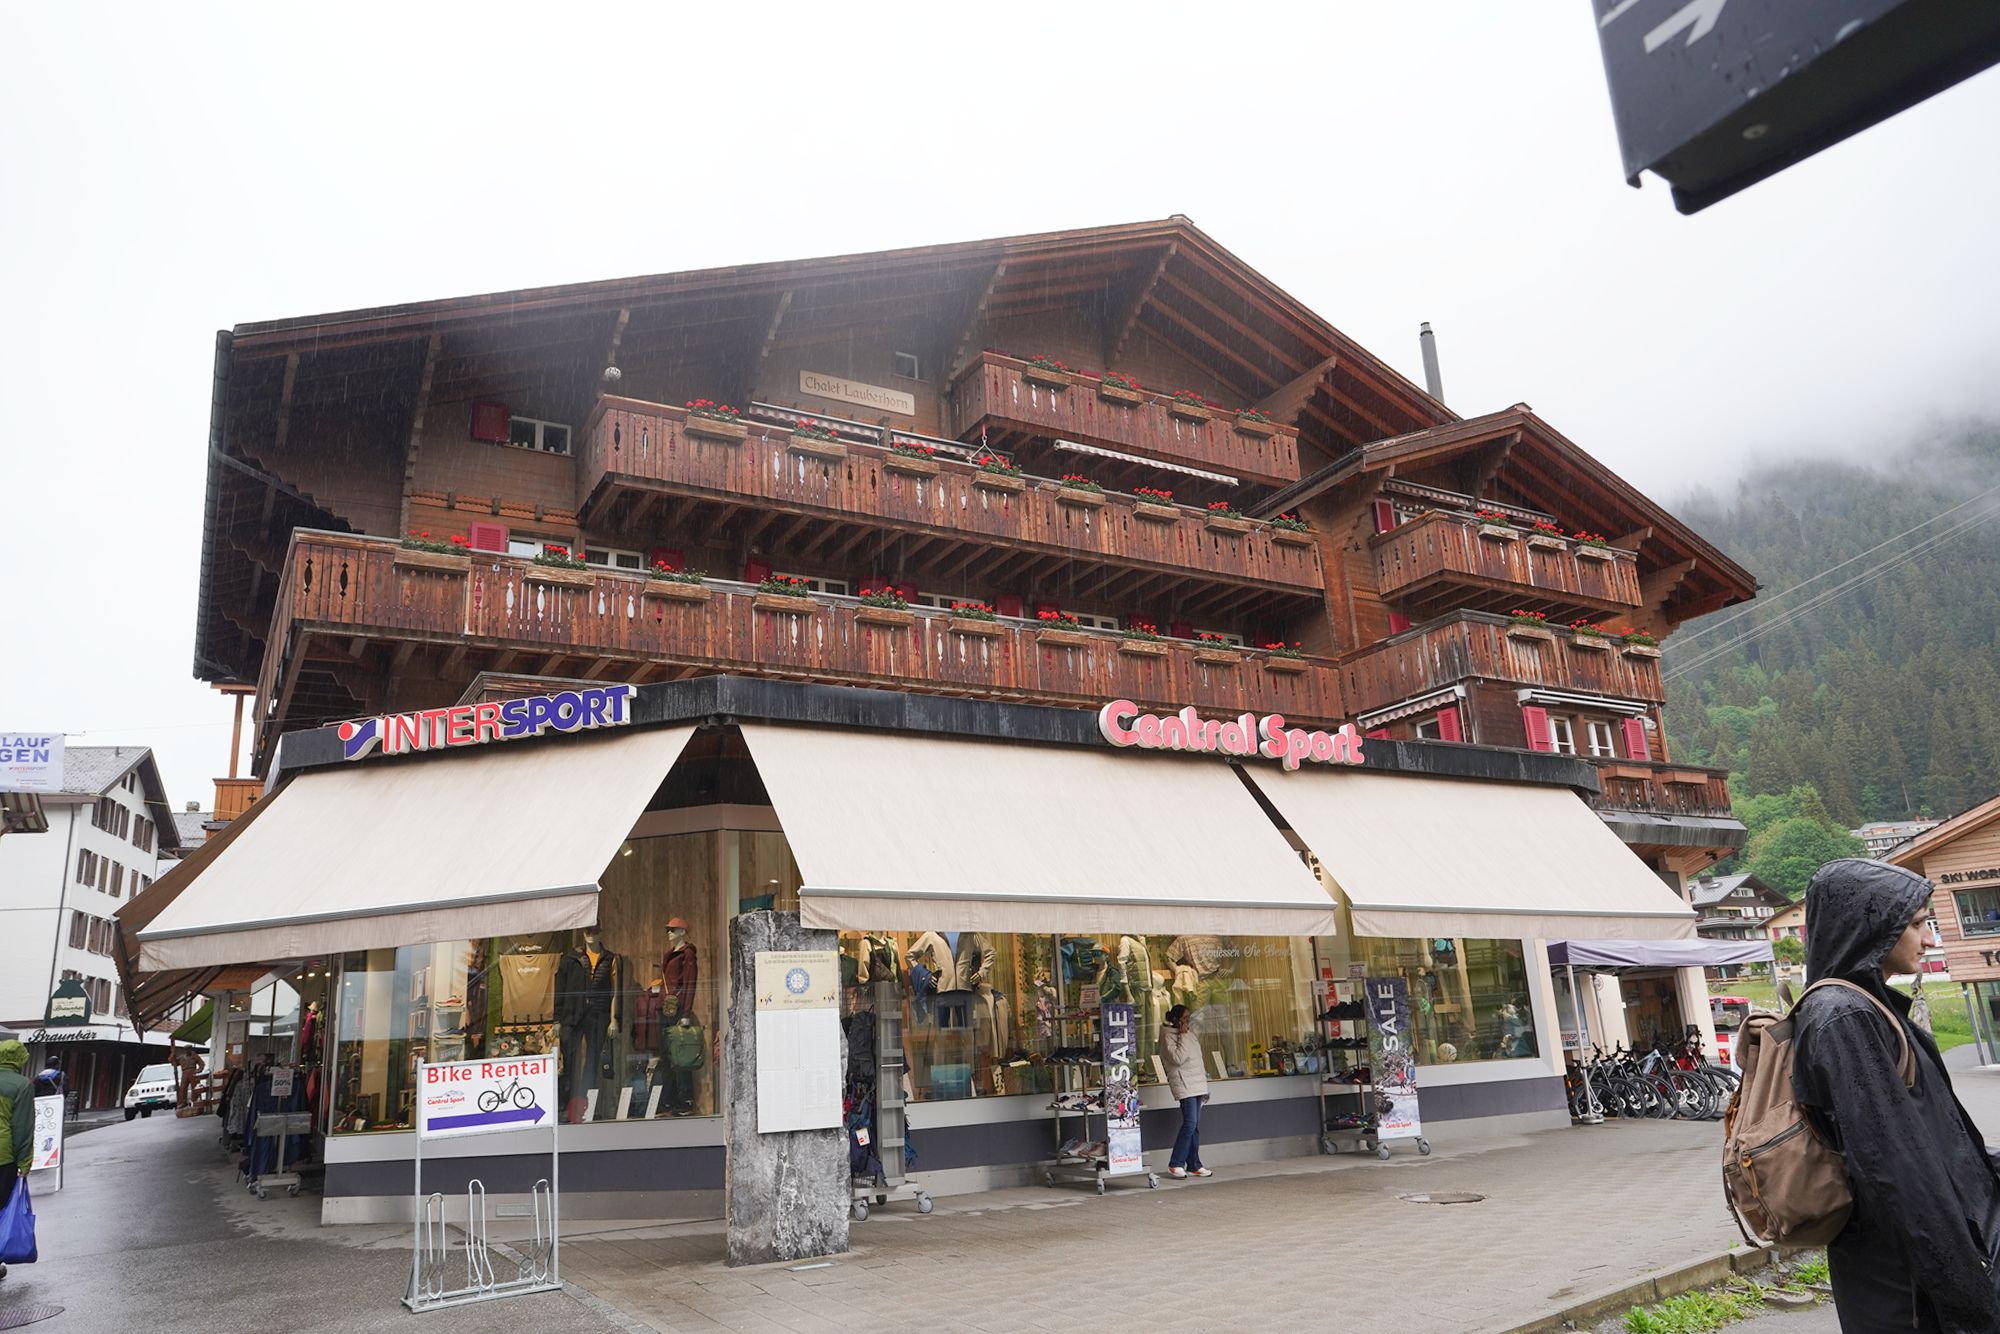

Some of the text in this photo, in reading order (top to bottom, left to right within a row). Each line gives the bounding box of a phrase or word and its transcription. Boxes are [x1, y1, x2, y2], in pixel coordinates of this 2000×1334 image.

[805, 376, 909, 409] Chalet Lauberhorn
[383, 685, 636, 754] INTERSPORT
[1100, 699, 1365, 771] Central Sport
[1941, 868, 2000, 884] SKI WOR
[1378, 983, 1400, 1052] SALE
[28, 1028, 98, 1045] Braunbär
[1108, 1010, 1131, 1082] SALE
[427, 1058, 547, 1084] Bike Rental
[427, 1097, 449, 1106] Central
[450, 1096, 465, 1105] Sport
